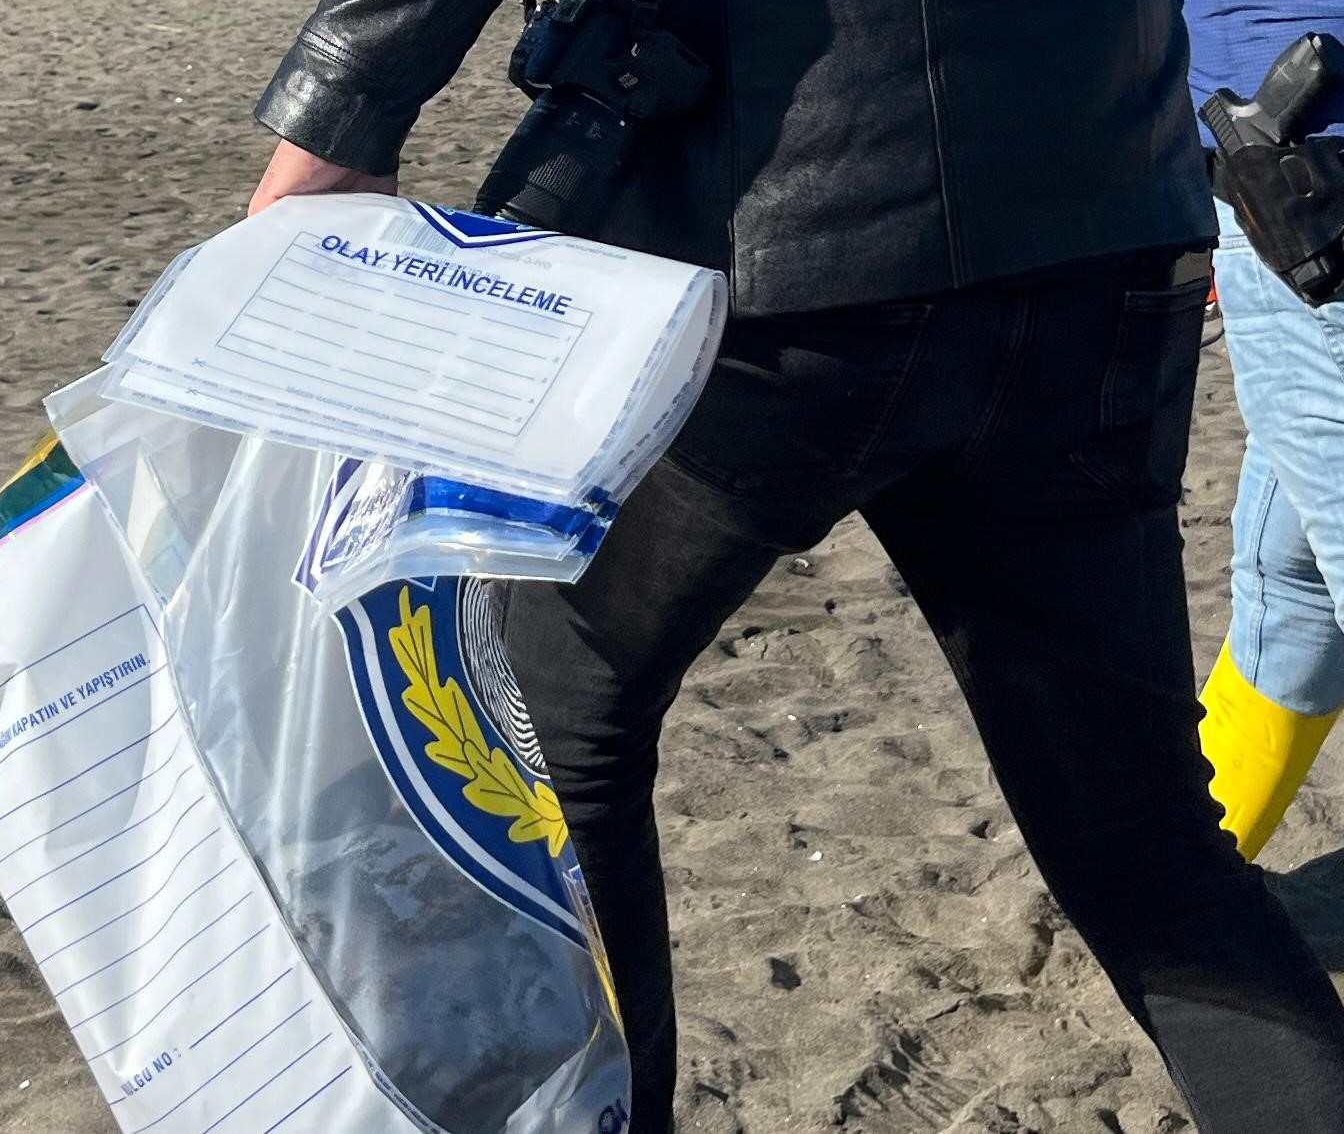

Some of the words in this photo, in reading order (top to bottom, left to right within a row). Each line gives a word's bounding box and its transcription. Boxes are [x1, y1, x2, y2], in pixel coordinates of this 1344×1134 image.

[321, 235, 388, 267] OLAY
[393, 254, 450, 283] YERİ
[447, 265, 573, 315] İNCELEME
[11, 702, 60, 738] KAPATIN
[59, 691, 78, 709] VE
[76, 653, 151, 699] YAPIŞTIRIN.
[152, 1051, 173, 1073] NO
